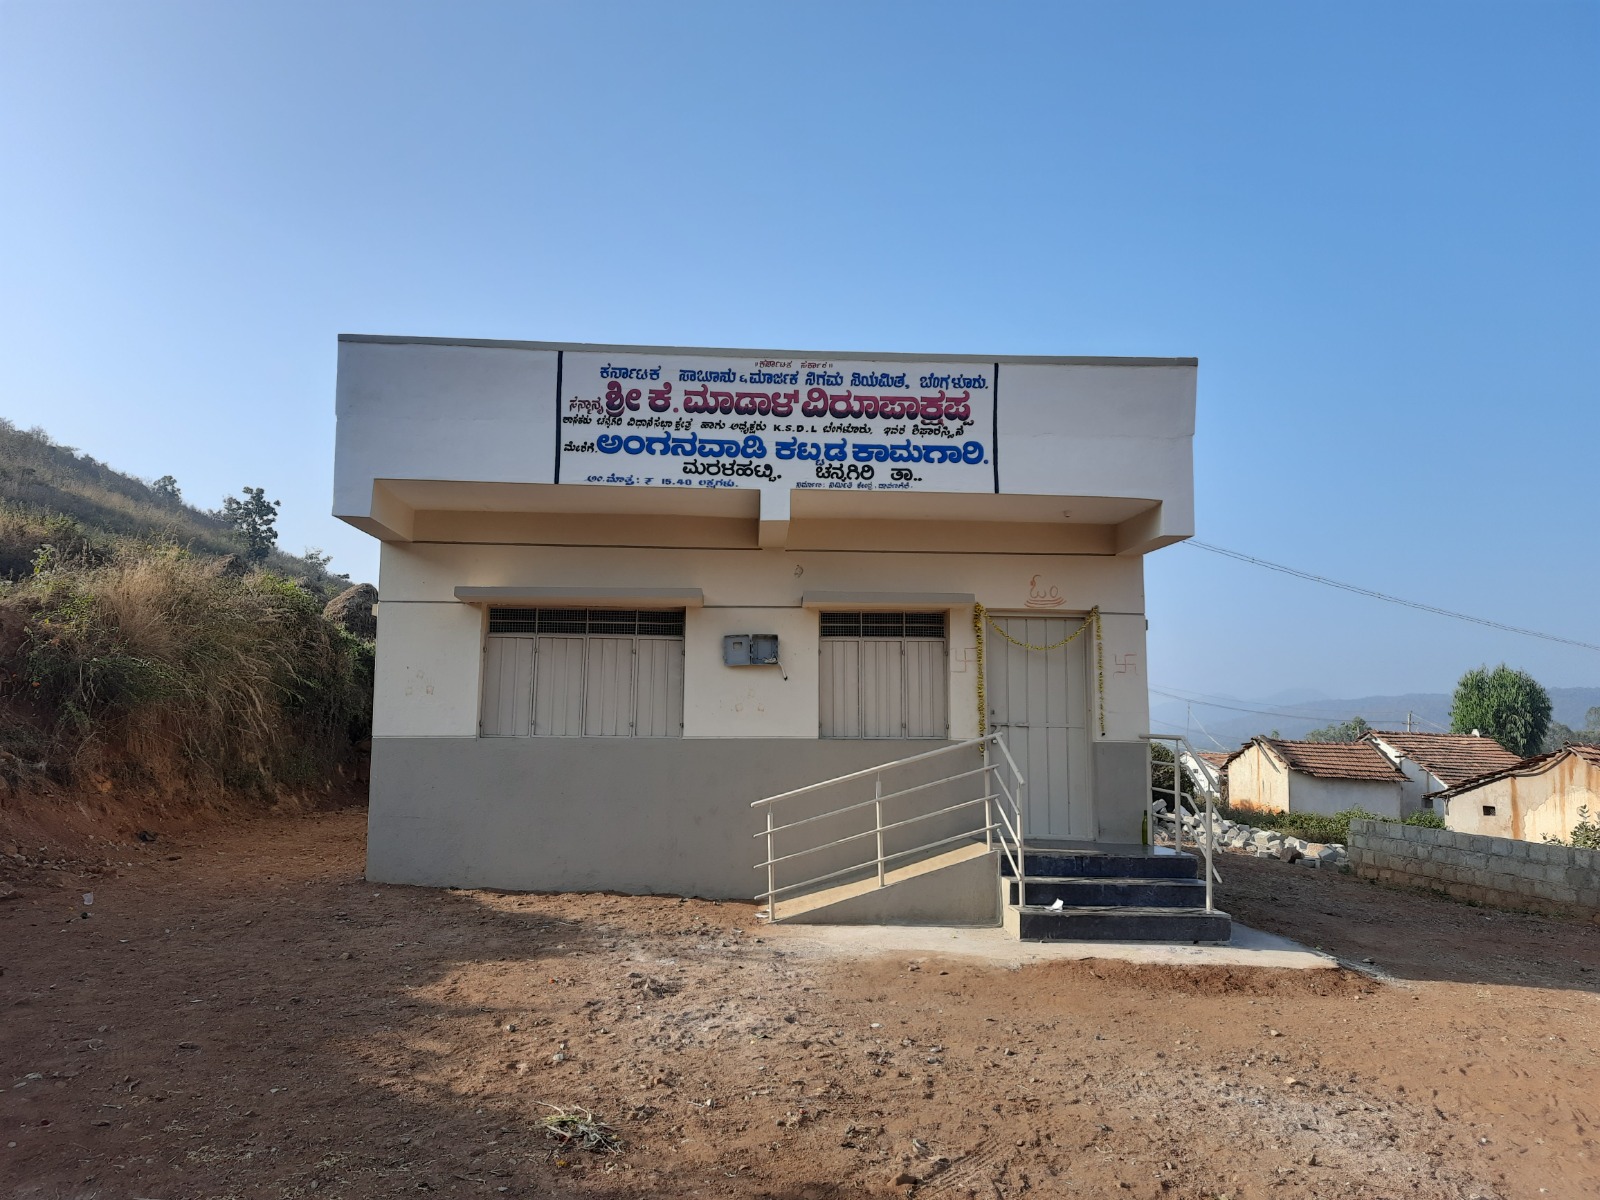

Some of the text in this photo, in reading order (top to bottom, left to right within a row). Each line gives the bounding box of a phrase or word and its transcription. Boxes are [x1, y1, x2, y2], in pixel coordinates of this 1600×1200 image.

[600, 363, 661, 381] ಕರ್ನಾಟಕ
[679, 368, 736, 383] ಸಾಬೂನು
[750, 370, 799, 386] ಮಾರ್ಜಕ
[805, 371, 843, 386] ನಿಗಮ
[605, 380, 641, 417] ಶ್ರೀ
[683, 384, 799, 417] ಮಾಡಾಳ್
[597, 431, 767, 459] ಅಂಗನವಾಡಿ
[775, 436, 847, 466] ಕಟ್ಟಡ
[852, 439, 989, 465] ಕಾಮಗಾರಿ.
[661, 478, 692, 486] 15.40
[816, 463, 875, 482] ಚನ್ನಗಿರಿ
